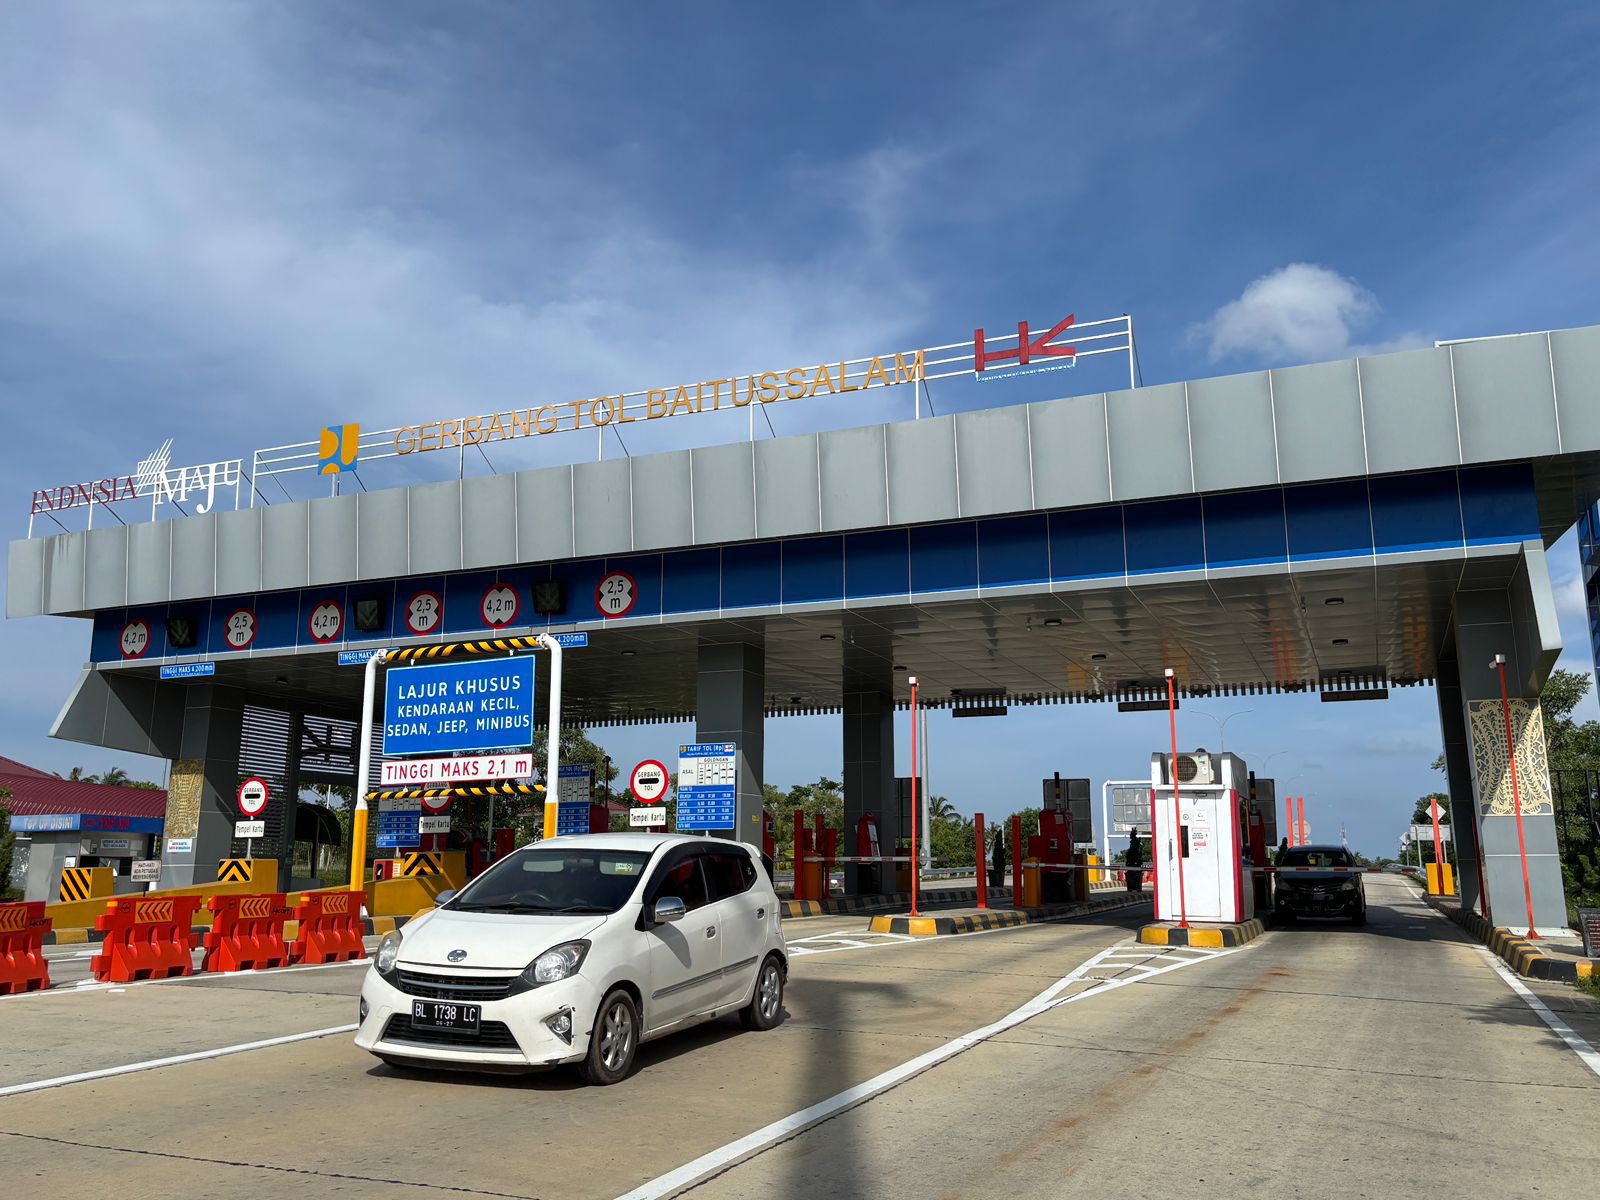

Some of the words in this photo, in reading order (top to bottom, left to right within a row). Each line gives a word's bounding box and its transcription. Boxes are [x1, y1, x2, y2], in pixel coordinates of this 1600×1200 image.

[975, 314, 1076, 372] HK
[394, 404, 558, 455] GERBANG
[568, 395, 634, 430] TOL
[646, 349, 925, 420] BAITUSSALAM
[155, 462, 239, 514] MAJU
[606, 580, 625, 596] 2,5
[416, 599, 432, 612] 2,5
[486, 599, 503, 613] 4,2
[504, 600, 514, 610] m
[610, 598, 622, 609] m
[234, 615, 248, 628] 2,5
[314, 615, 329, 628] 4,2
[330, 615, 338, 626] m
[418, 614, 428, 626] m
[124, 632, 136, 644] 4,2
[138, 634, 146, 643] m
[236, 632, 244, 642] m
[340, 652, 358, 661] TINGGI
[358, 651, 372, 659] MAKS
[398, 682, 448, 700] LAJUR
[455, 675, 521, 696] KHUSUS
[397, 701, 474, 718] KENDARAAN
[480, 697, 520, 712] KECIL,
[387, 723, 432, 738] SEDAN,
[436, 719, 469, 734] JEEP,
[476, 715, 530, 730] MINIBUS
[386, 764, 434, 780] TINGGI
[440, 761, 479, 777] MAKS
[488, 760, 507, 777] 2,1
[515, 760, 527, 773] m
[50, 816, 73, 829] DISINI
[420, 819, 436, 830] Tempel
[438, 819, 450, 828] Kartu
[631, 813, 650, 824] Tempel
[651, 813, 665, 822] Kartu
[237, 825, 251, 835] Tempel
[252, 824, 264, 833] Kartu
[415, 1003, 427, 1018] BL
[434, 1004, 457, 1020] 1738
[464, 1007, 476, 1022] LC
